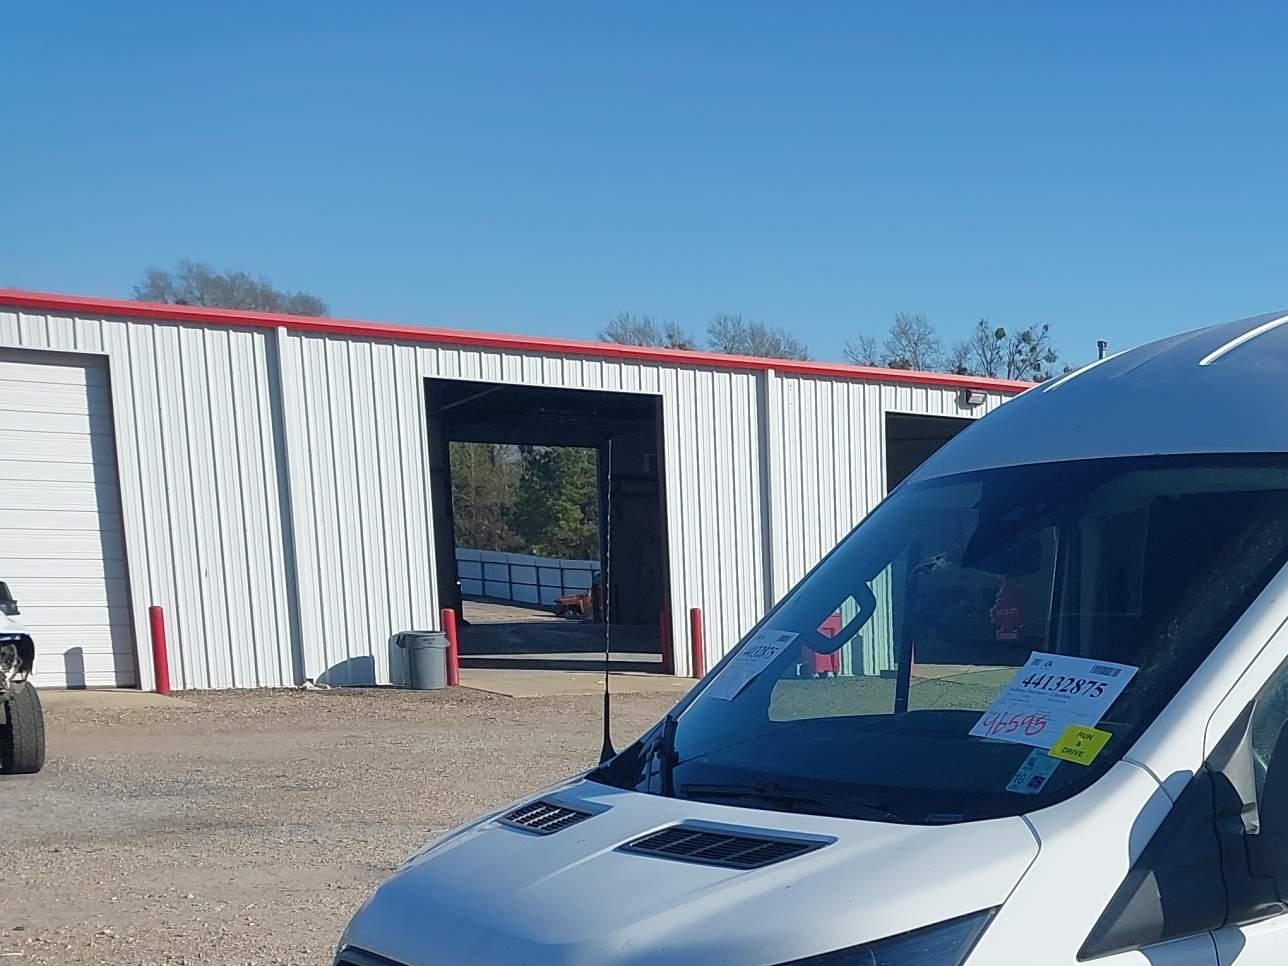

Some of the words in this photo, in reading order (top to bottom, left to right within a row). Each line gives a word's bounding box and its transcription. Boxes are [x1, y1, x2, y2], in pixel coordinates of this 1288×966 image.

[1022, 673, 1109, 697] 44132875
[1077, 731, 1095, 741] RUN
[1061, 747, 1085, 758] DRIVE
